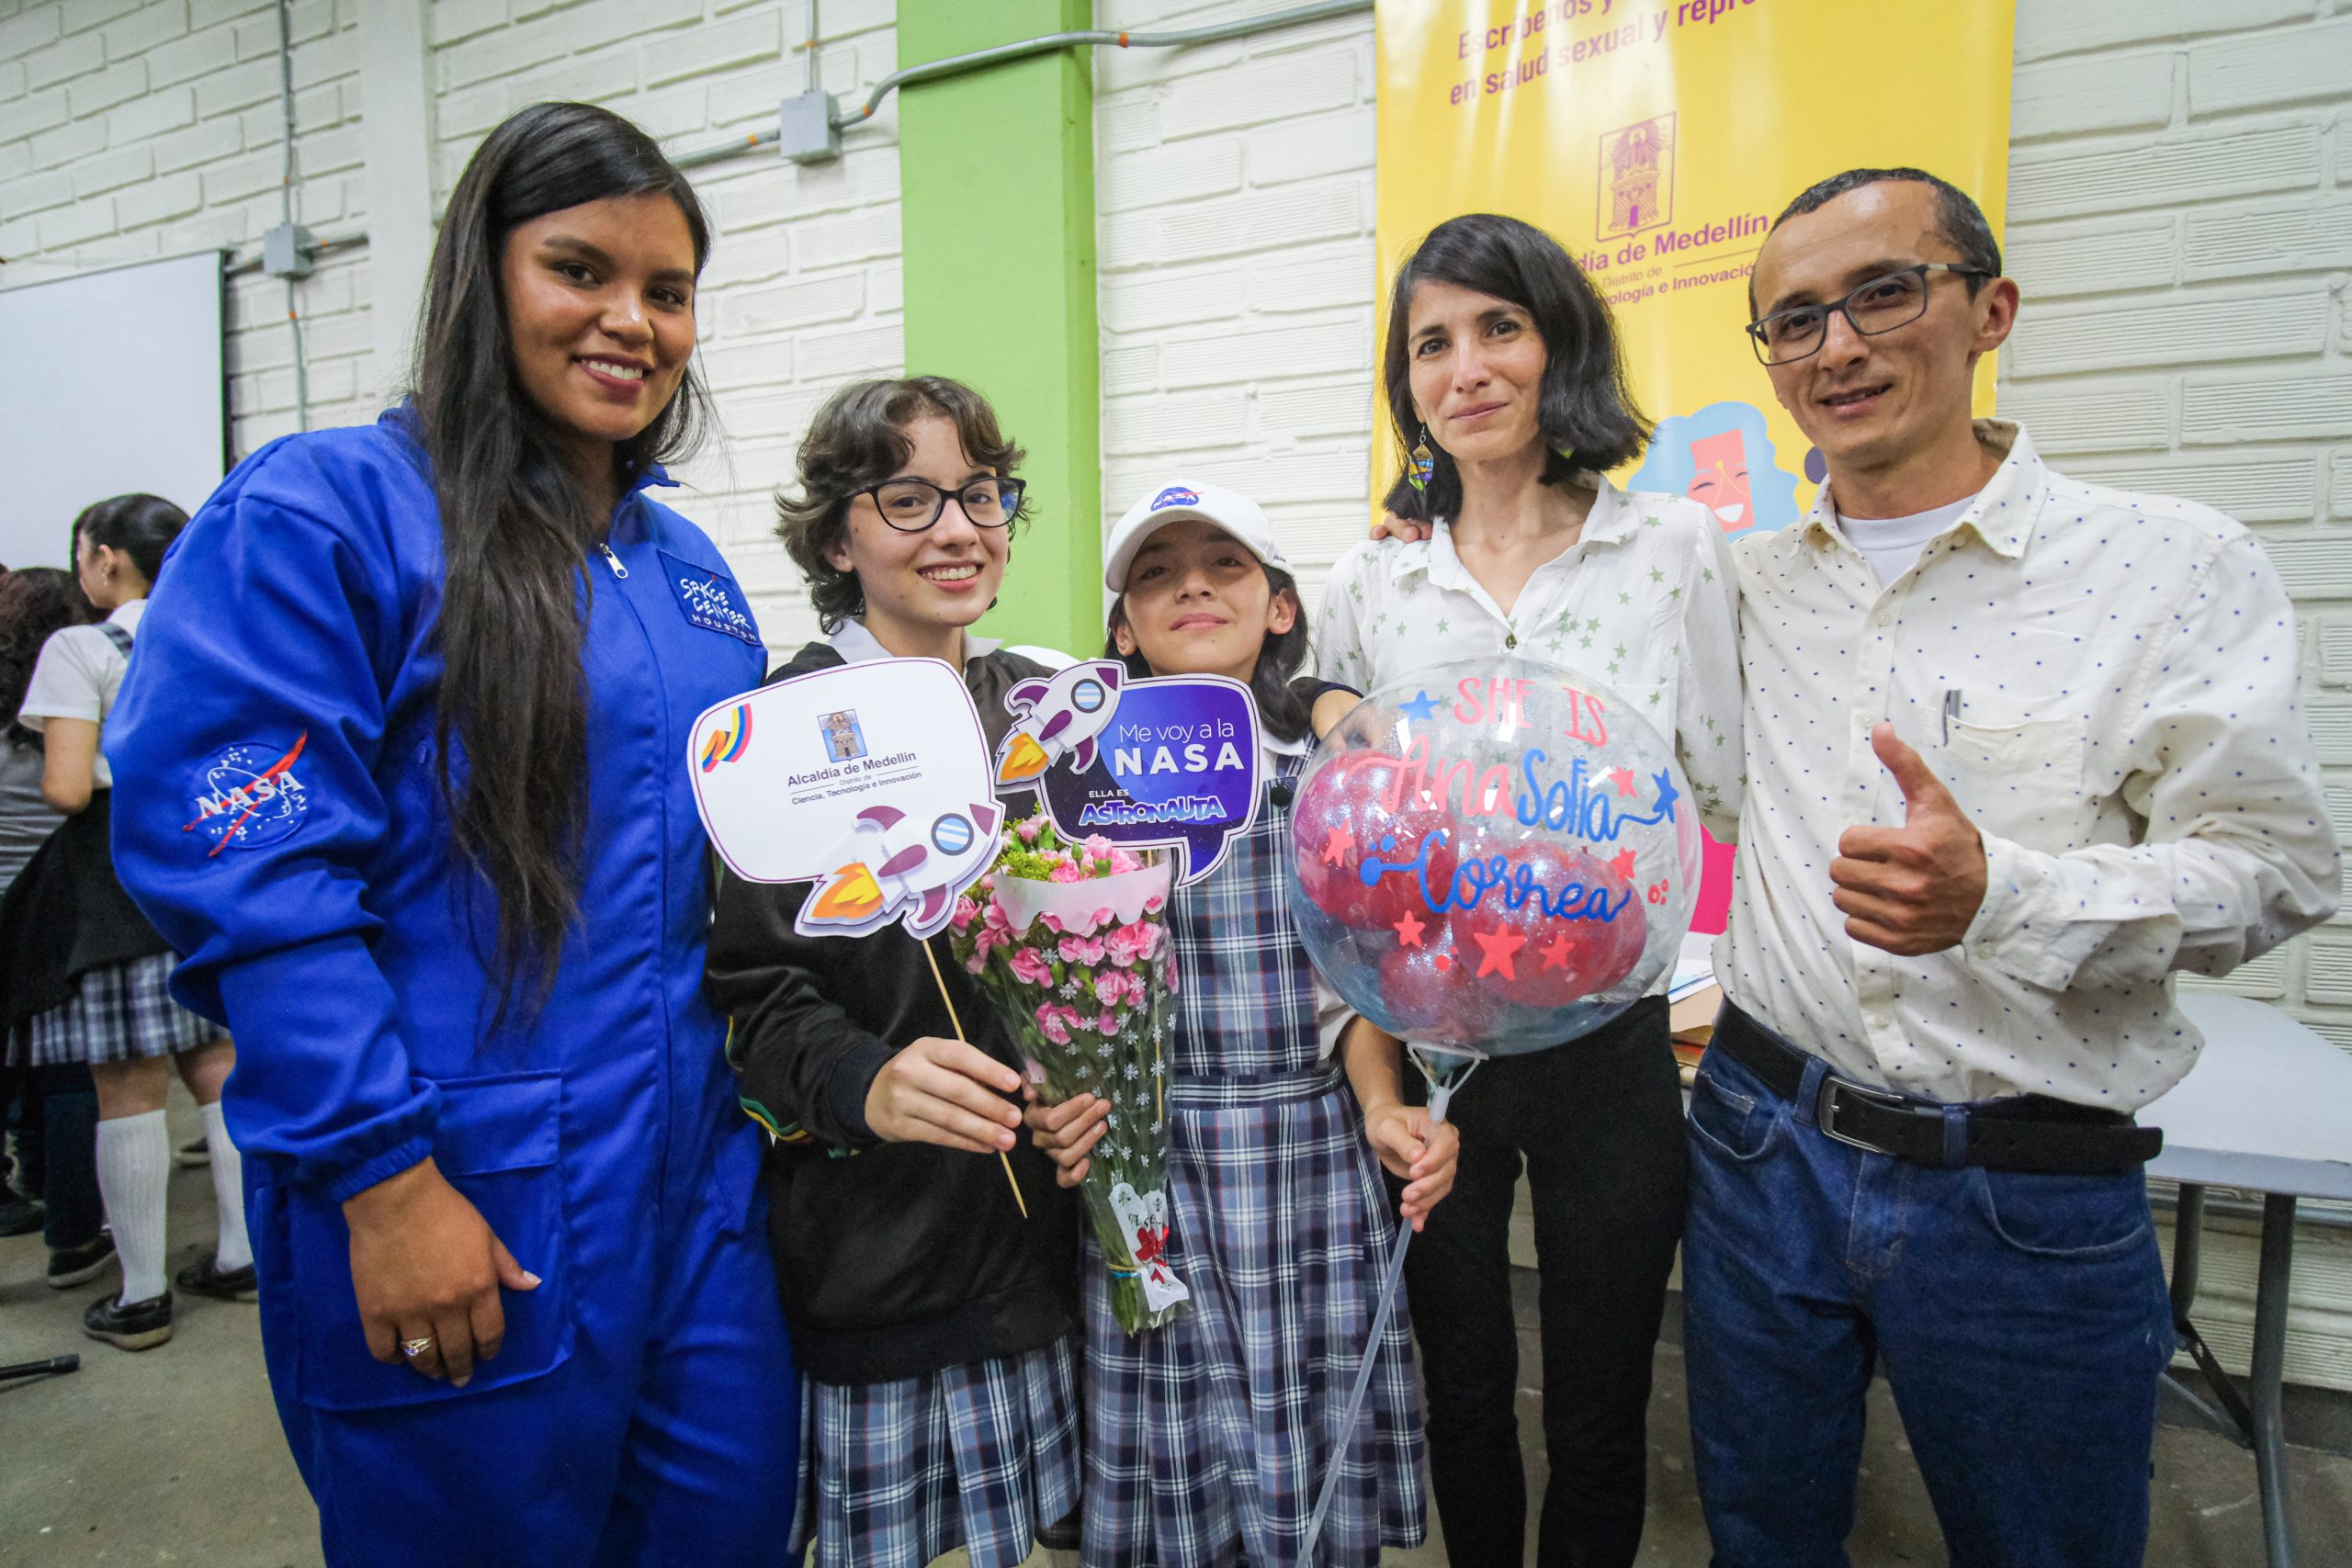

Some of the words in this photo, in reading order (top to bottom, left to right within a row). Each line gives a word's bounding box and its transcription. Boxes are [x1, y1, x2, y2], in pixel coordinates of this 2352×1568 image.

[1451, 78, 1476, 105] en
[1486, 47, 1548, 94] salud
[1557, 12, 1644, 68] sexual
[1653, 9, 1668, 42] y
[1679, 0, 1756, 27] rep
[1616, 243, 1646, 265] de
[1654, 213, 1769, 256] Medellín
[1601, 270, 1644, 288] Distrito
[1647, 265, 1662, 278] de
[1605, 284, 1654, 305] ología
[1658, 282, 1668, 293] e
[1672, 263, 1754, 291] Innovació
[693, 597, 752, 630] CENTER
[1119, 724, 1152, 743] Me
[1156, 725, 1194, 743] voy
[1199, 723, 1212, 739] a
[1217, 717, 1235, 738] la
[1453, 677, 1537, 729] SHE
[1563, 686, 1608, 748] IS
[787, 765, 841, 787] Alcaldía
[843, 763, 860, 775] de
[863, 751, 917, 772] Medellín
[1114, 741, 1245, 776] NASA
[195, 771, 306, 819] NASA
[791, 793, 826, 806] Ciencia,
[826, 781, 871, 797] Tecnología
[878, 772, 922, 787] Innovación
[1089, 790, 1114, 798] ELLA
[1116, 789, 1129, 797] ES
[1079, 795, 1227, 826] ASTRONAUTA
[1408, 830, 1631, 922] Correa
